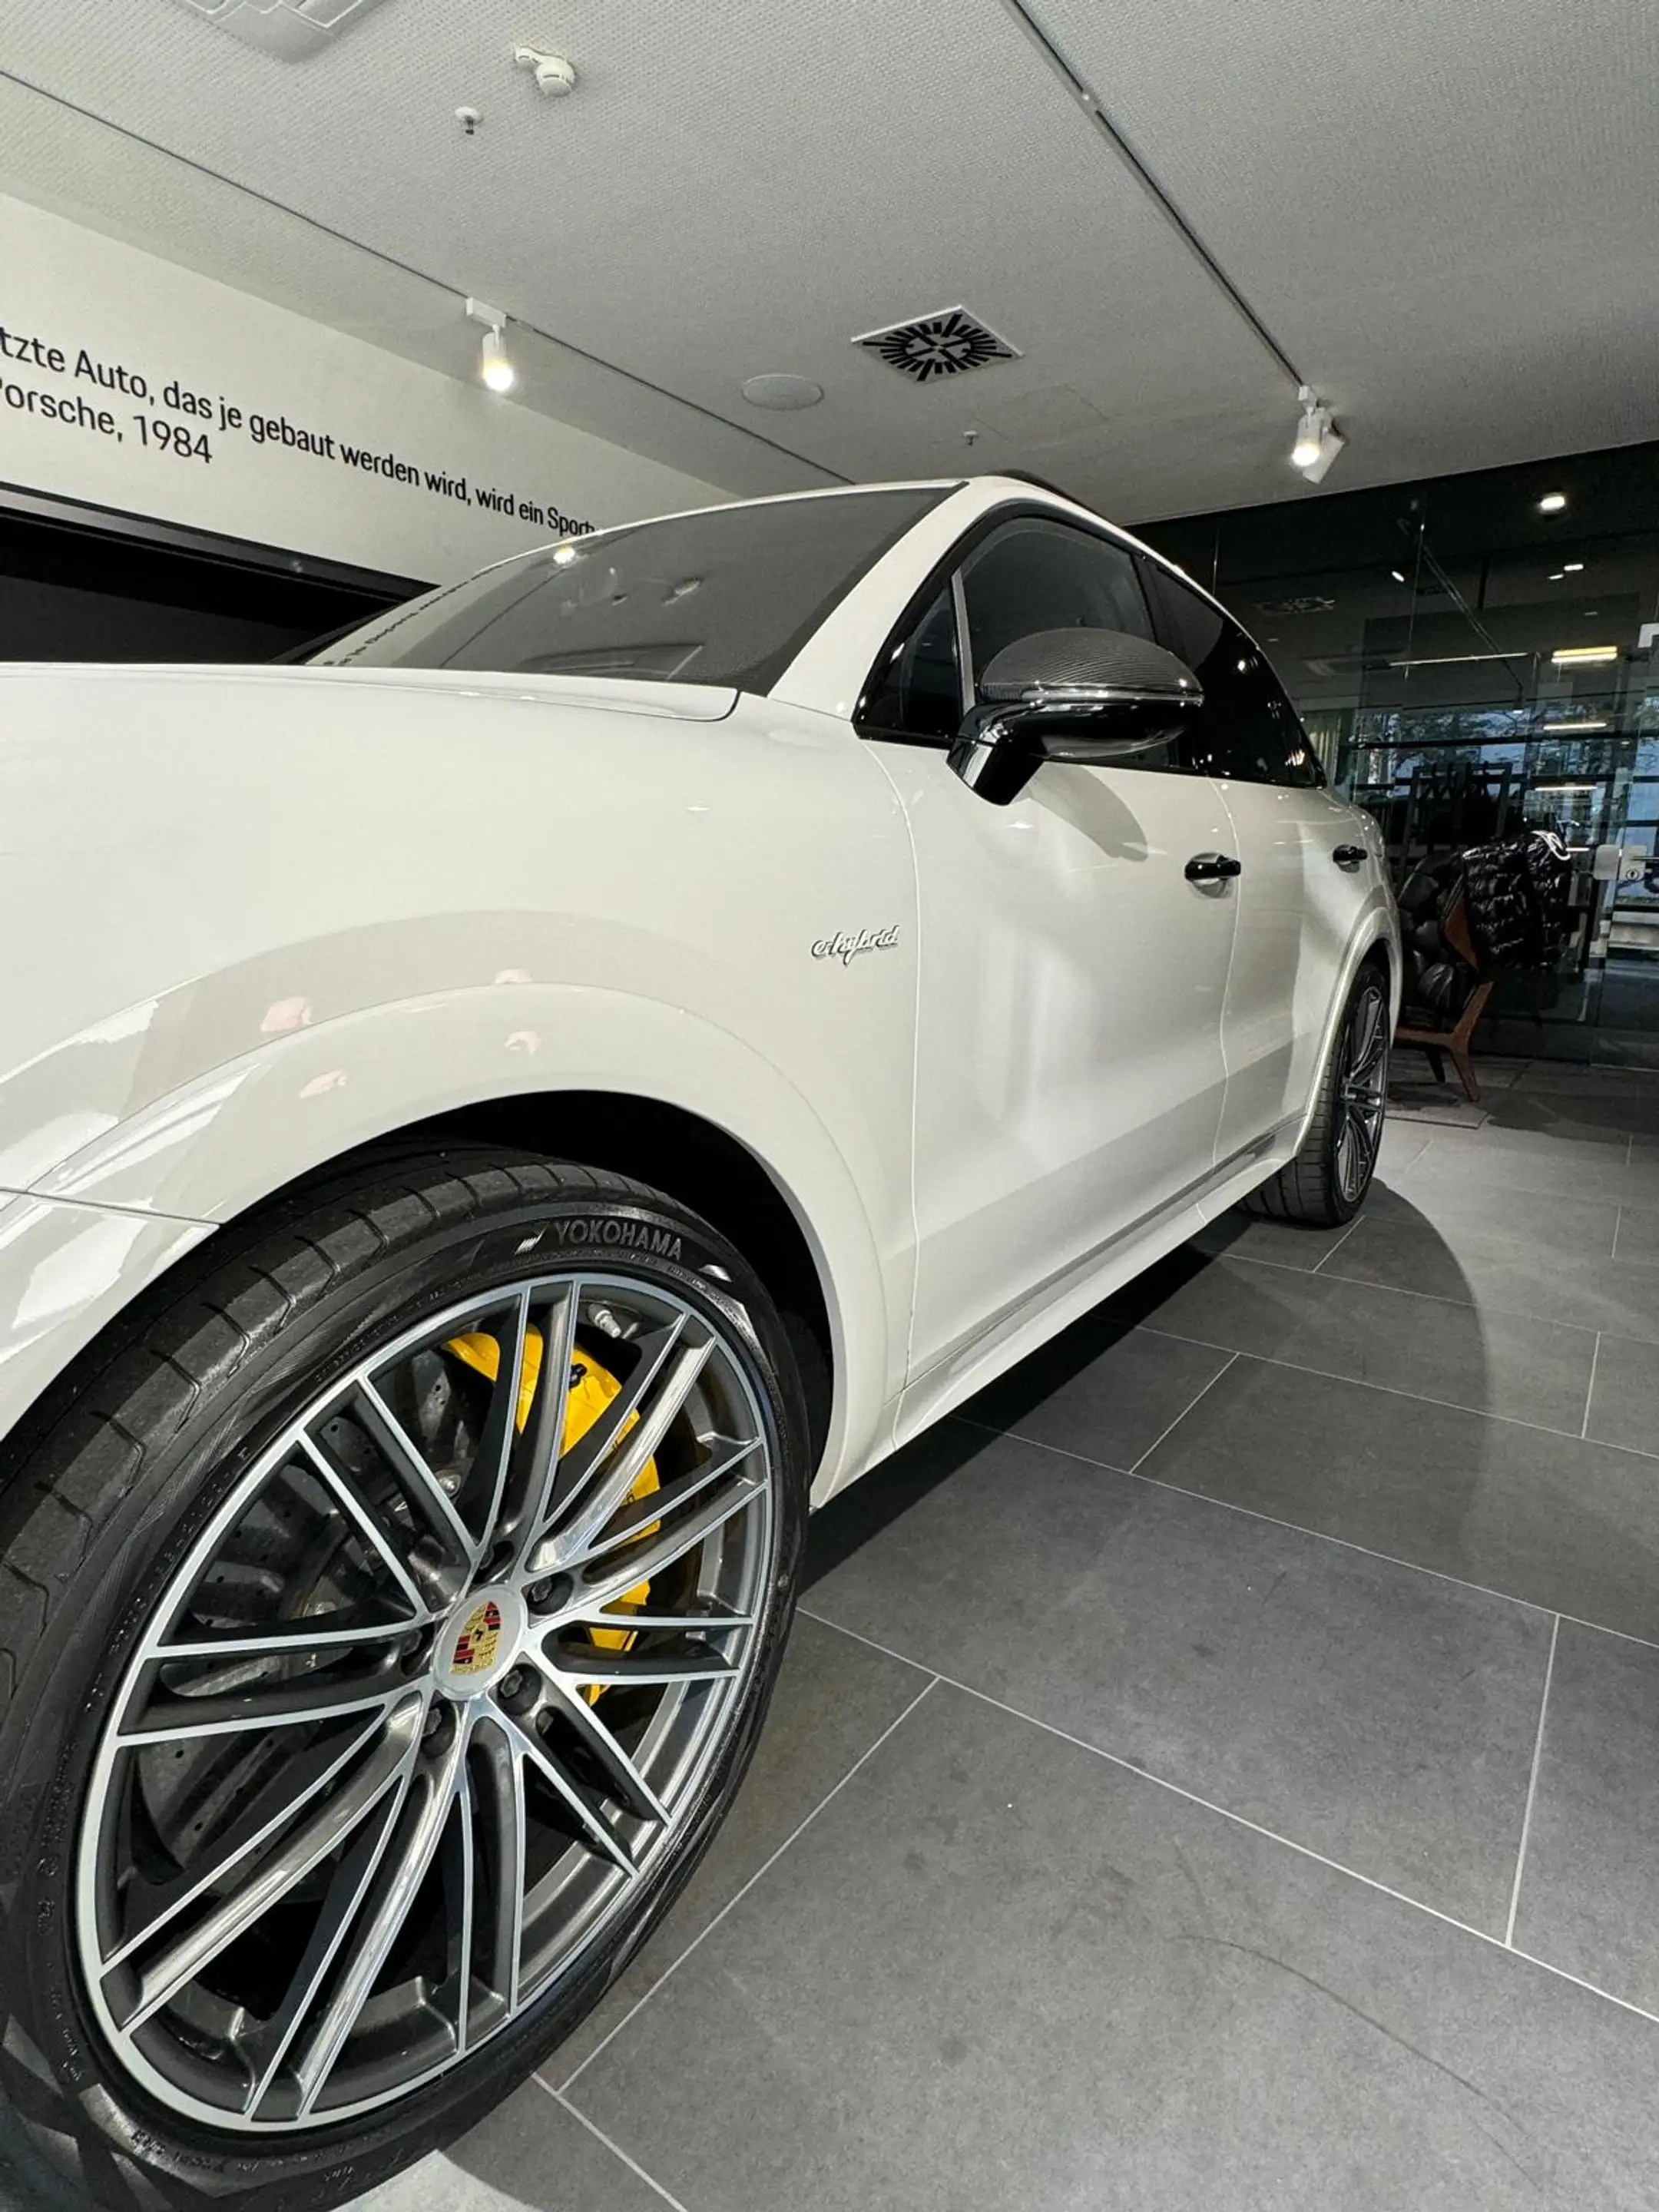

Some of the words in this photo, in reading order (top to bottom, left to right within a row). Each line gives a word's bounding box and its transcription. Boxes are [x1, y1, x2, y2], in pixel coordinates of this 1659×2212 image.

[0, 376, 123, 442] orsche,
[133, 416, 213, 463] 1984
[75, 349, 155, 406] Auto,
[163, 381, 213, 419] das
[218, 396, 243, 432] je
[249, 415, 336, 460] gebaut
[339, 444, 420, 486] werden
[424, 471, 472, 507] wird,
[475, 488, 515, 516] wird
[518, 501, 544, 525] ein
[553, 1219, 681, 1260] YOKOHAMA
